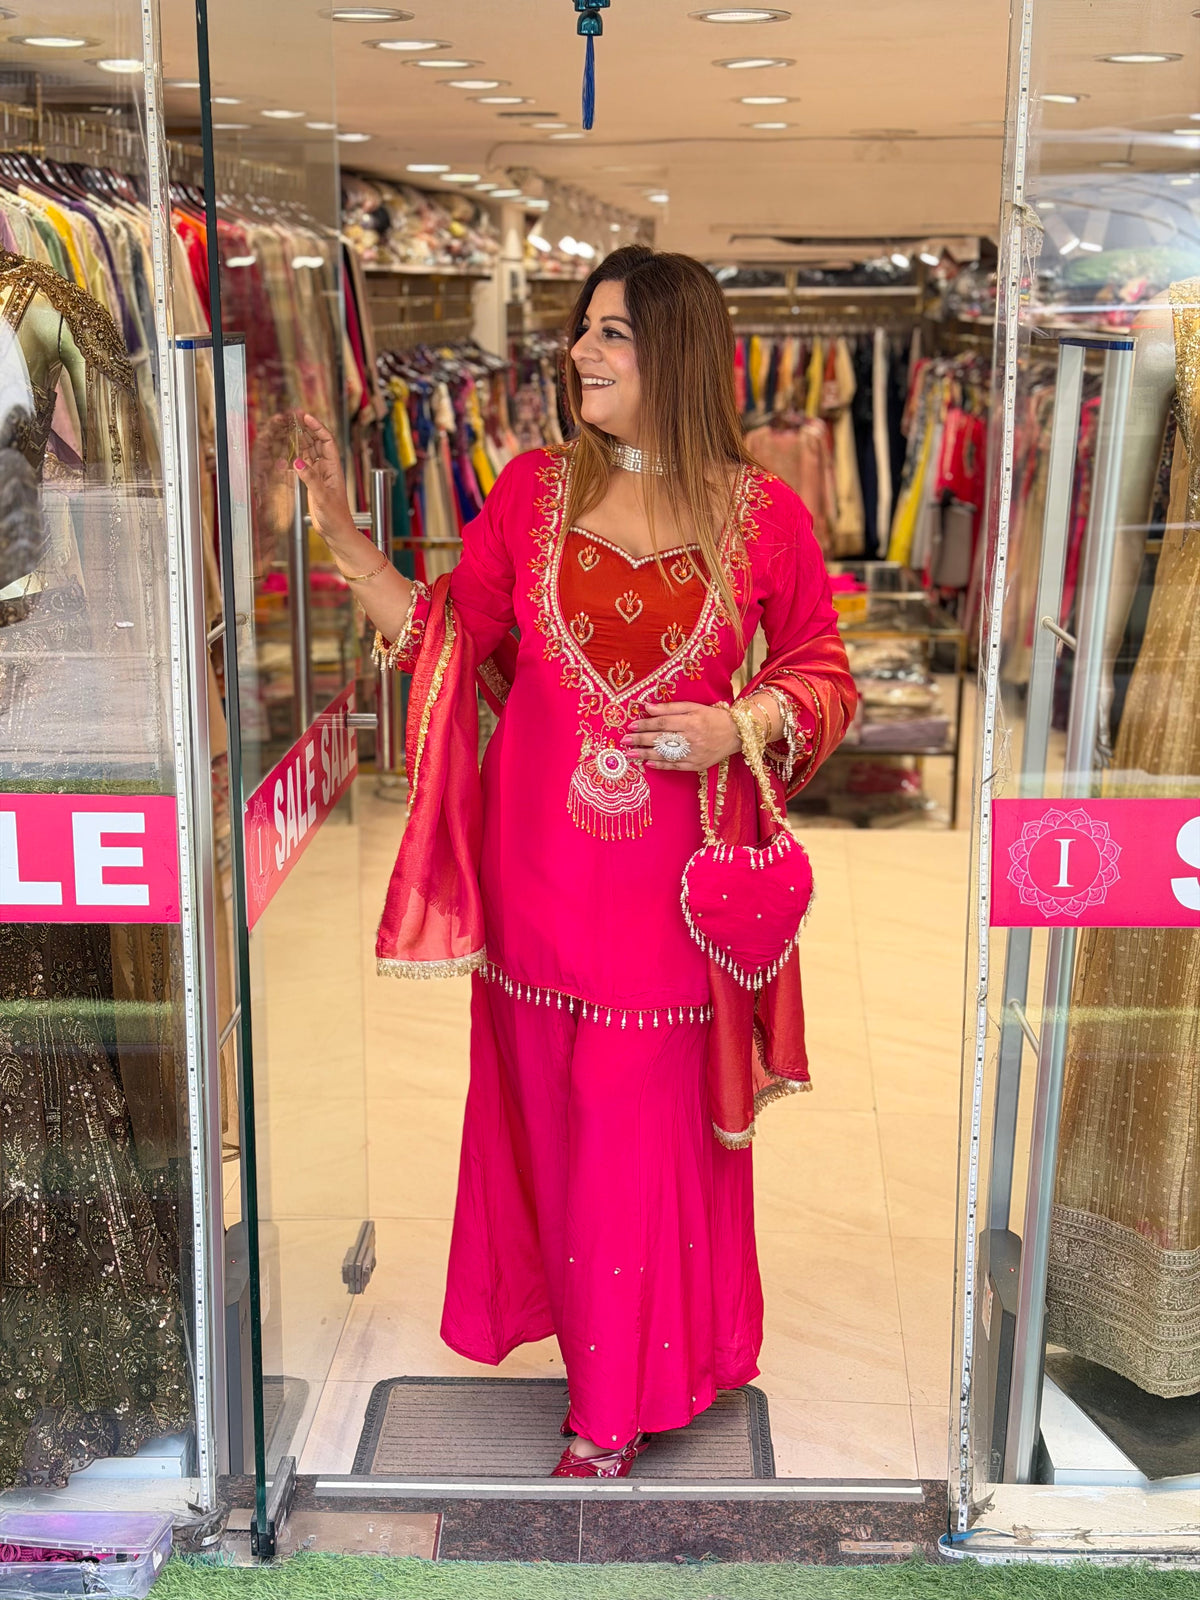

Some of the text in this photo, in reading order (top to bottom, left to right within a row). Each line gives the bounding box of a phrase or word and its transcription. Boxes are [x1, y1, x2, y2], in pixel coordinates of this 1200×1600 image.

[274, 739, 316, 871] SALE
[321, 693, 356, 805] SALE
[1052, 838, 1077, 888] I
